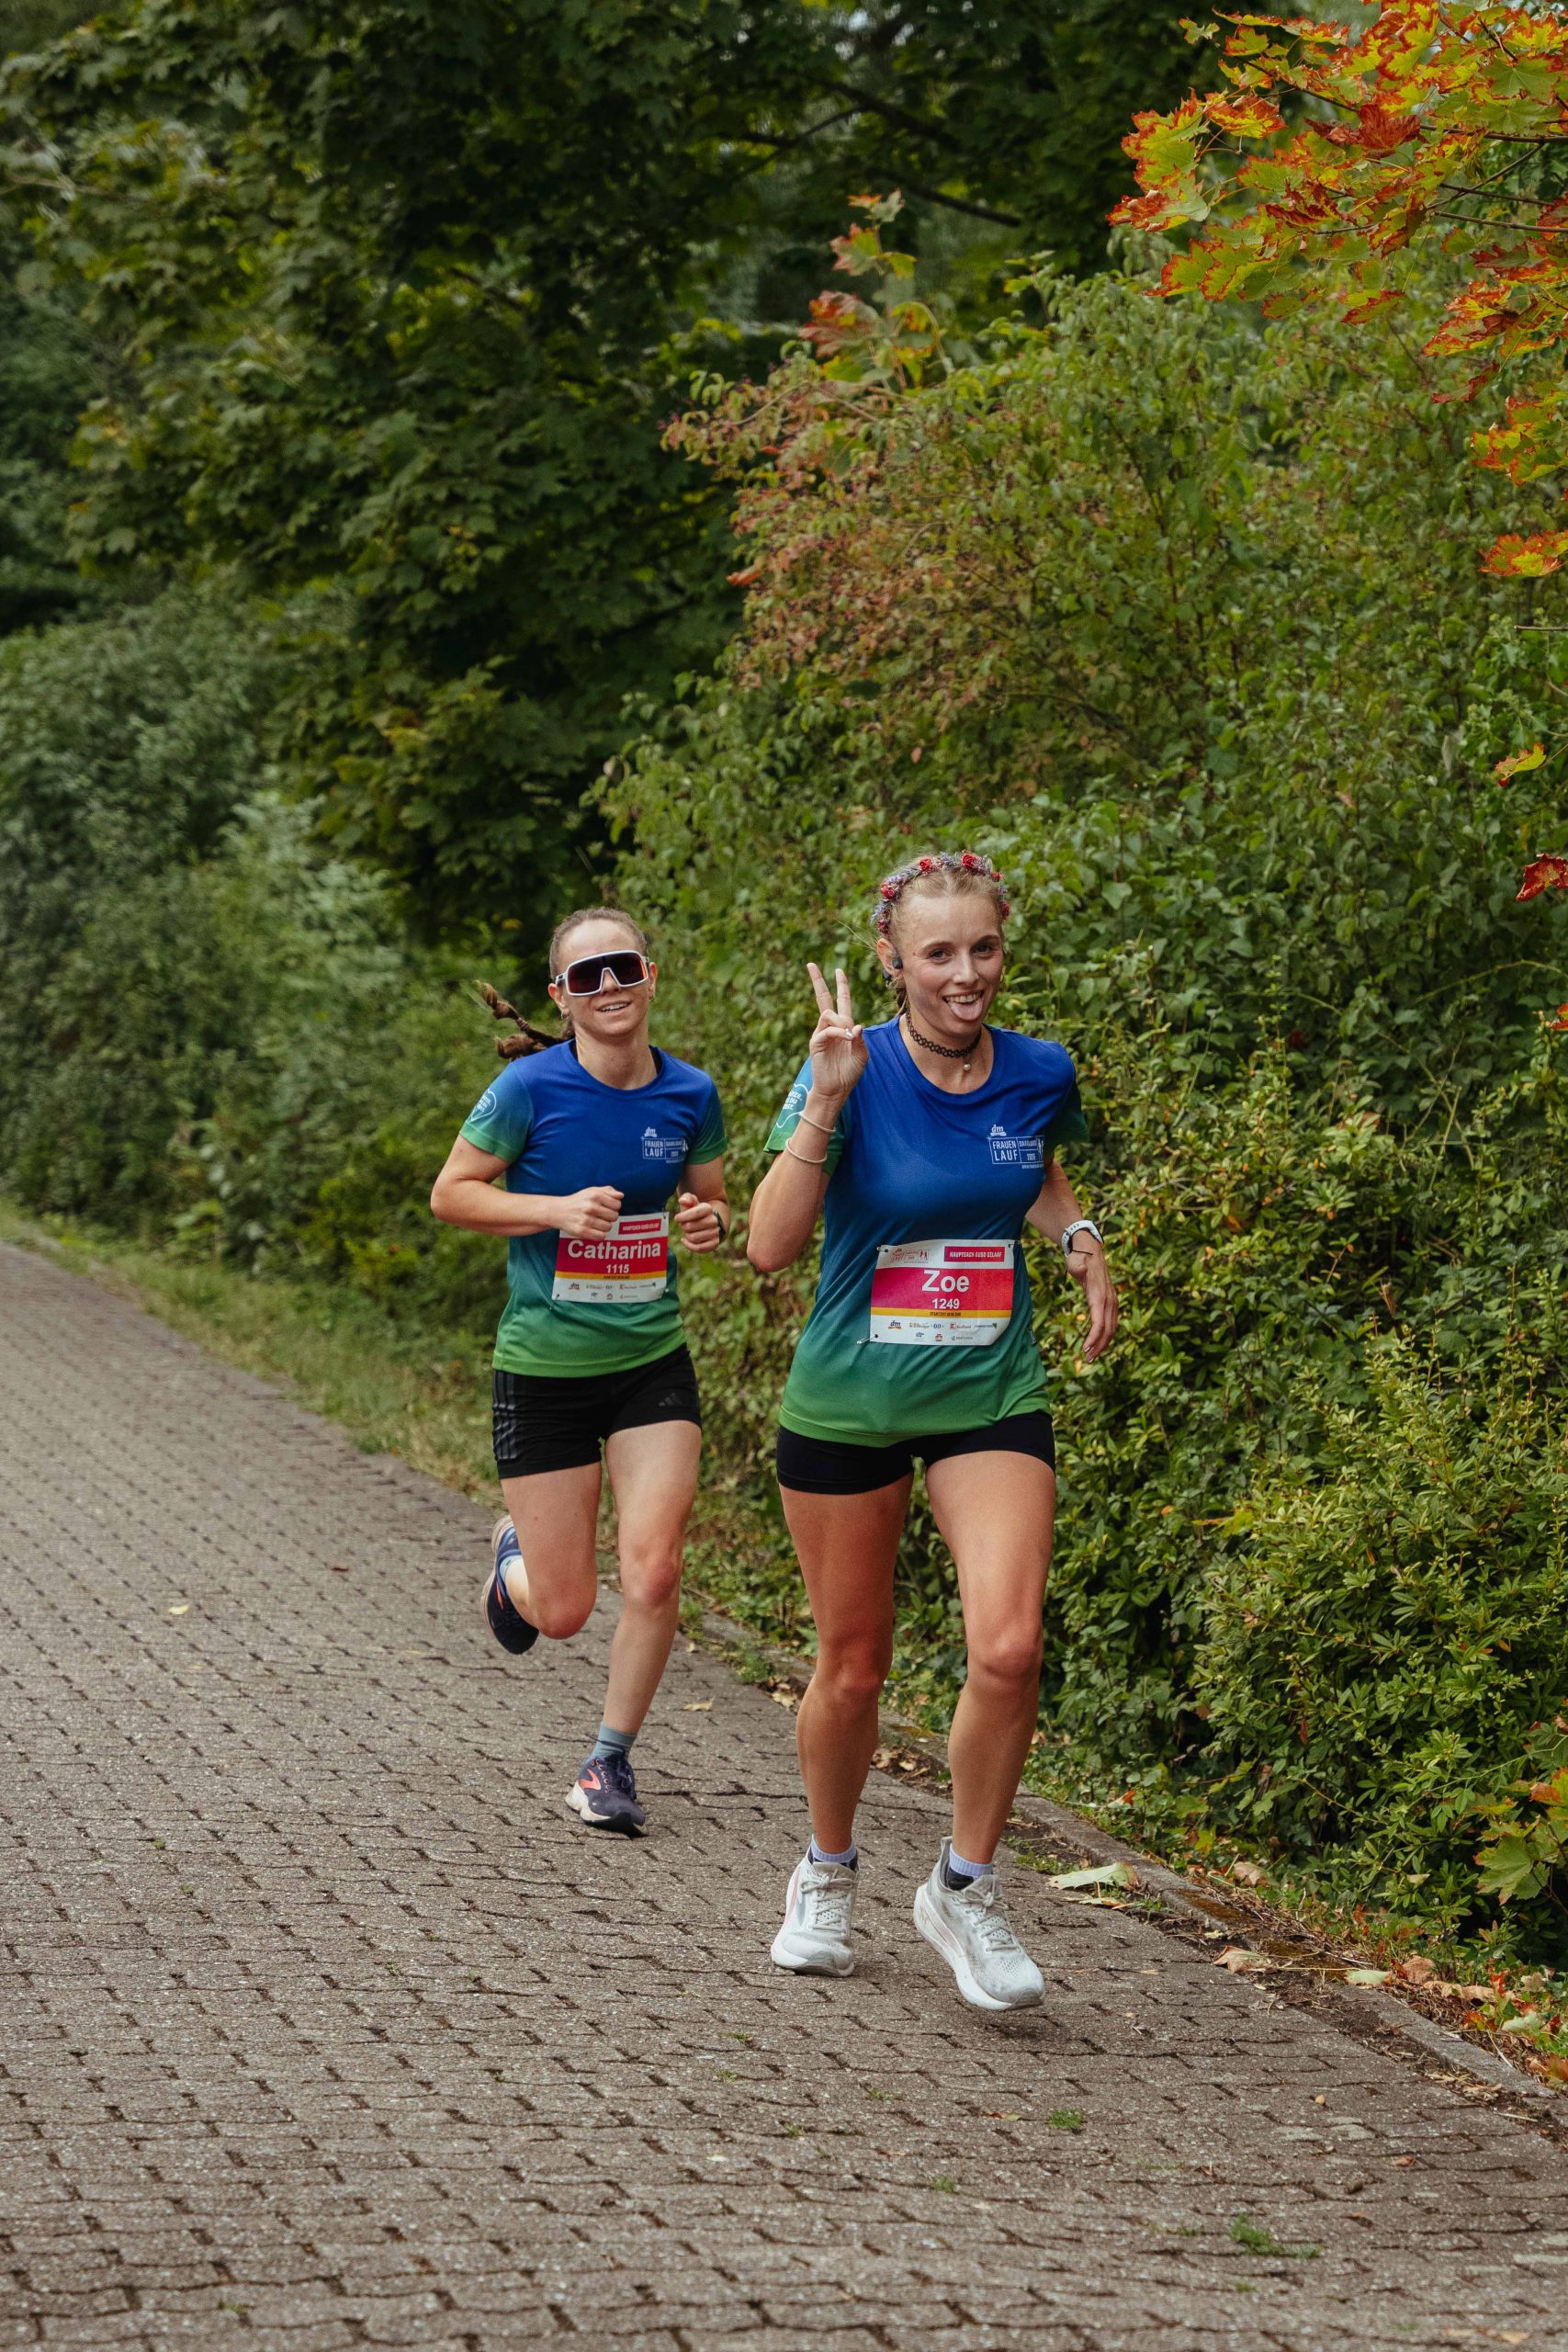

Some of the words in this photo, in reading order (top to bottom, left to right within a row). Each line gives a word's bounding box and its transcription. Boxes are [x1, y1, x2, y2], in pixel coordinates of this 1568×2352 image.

[646, 1126, 656, 1135] dm
[991, 1124, 1004, 1133] dm
[645, 1140, 664, 1148] FRAUEN
[992, 1139, 1017, 1149] FRAUEN
[645, 1148, 664, 1158] LAUF
[994, 1149, 1018, 1161] LAUF
[568, 1238, 661, 1260] Catharina
[605, 1263, 630, 1274] 1115
[921, 1270, 970, 1293] Zoe
[931, 1298, 960, 1309] 1249
